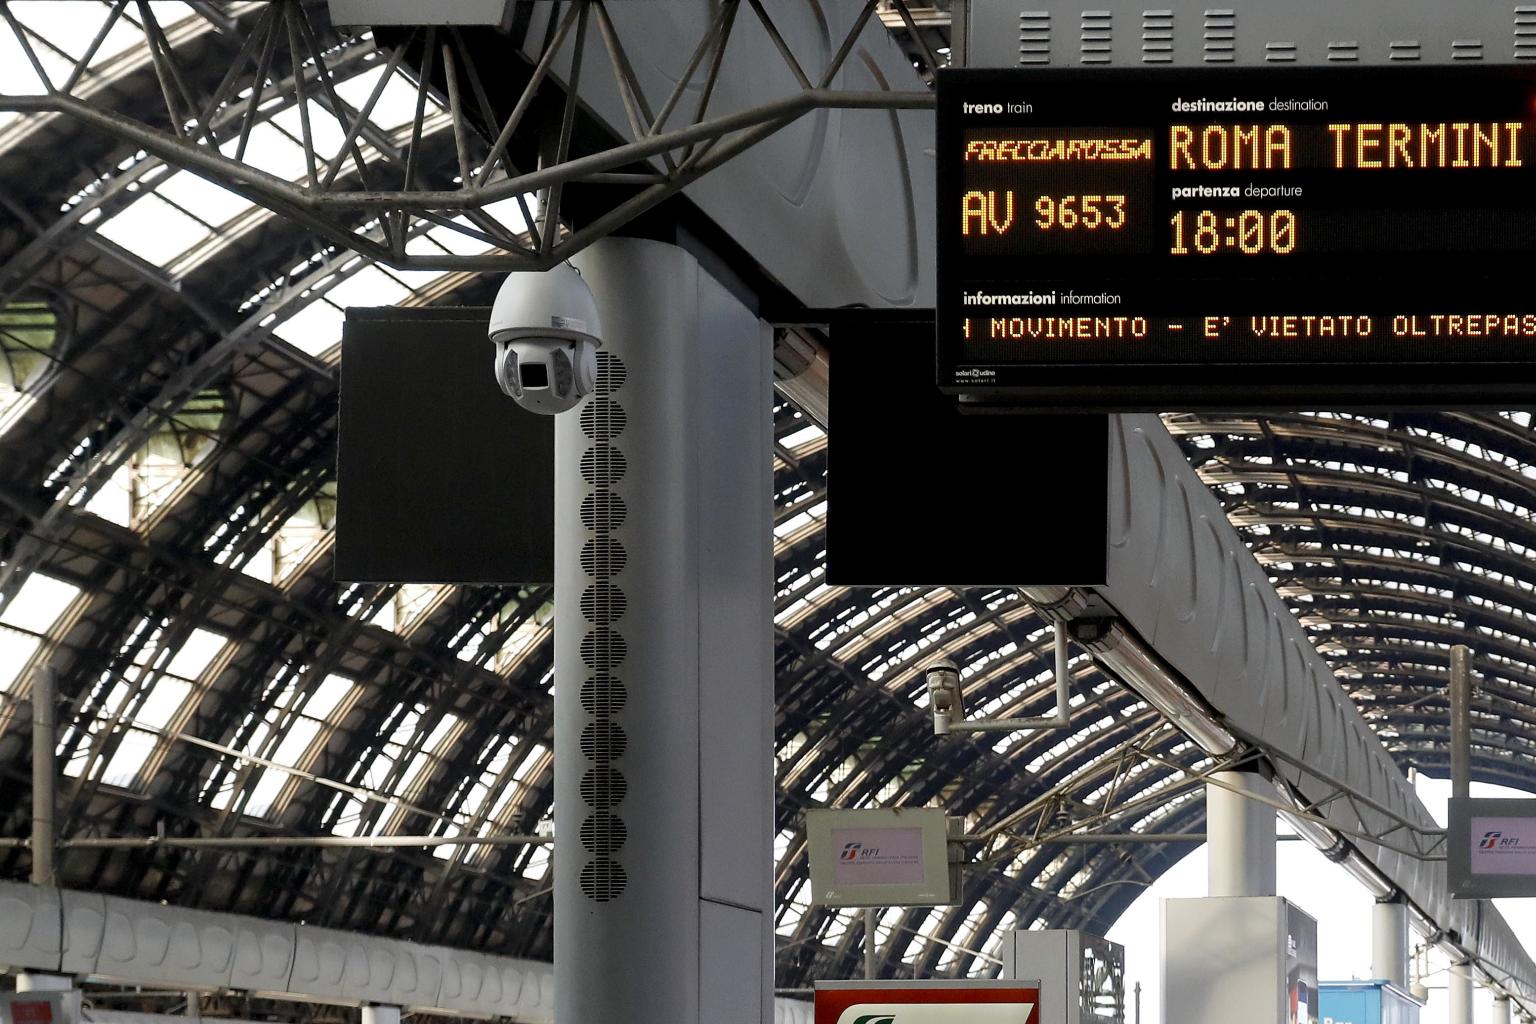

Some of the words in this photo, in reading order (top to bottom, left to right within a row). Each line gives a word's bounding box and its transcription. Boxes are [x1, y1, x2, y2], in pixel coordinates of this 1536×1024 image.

[963, 102, 1003, 115] treno
[1007, 101, 1033, 115] train
[1172, 97, 1265, 113] destinazione
[1269, 97, 1329, 112] destination
[1170, 124, 1291, 170] ROMA
[1328, 121, 1523, 169] TERMINI
[1172, 184, 1241, 201] partenza
[1244, 183, 1303, 200] departure
[961, 190, 1014, 235] AV
[1034, 194, 1127, 230] 9653
[1170, 209, 1297, 255] 18:00
[963, 290, 1057, 306] informazioni
[1060, 289, 1122, 305] information
[991, 317, 1147, 338] MOVIMENTO
[1204, 316, 1231, 337] E'
[1251, 315, 1372, 337] VIETATO
[1499, 838, 1520, 846] RFI
[861, 848, 881, 857] RFI
